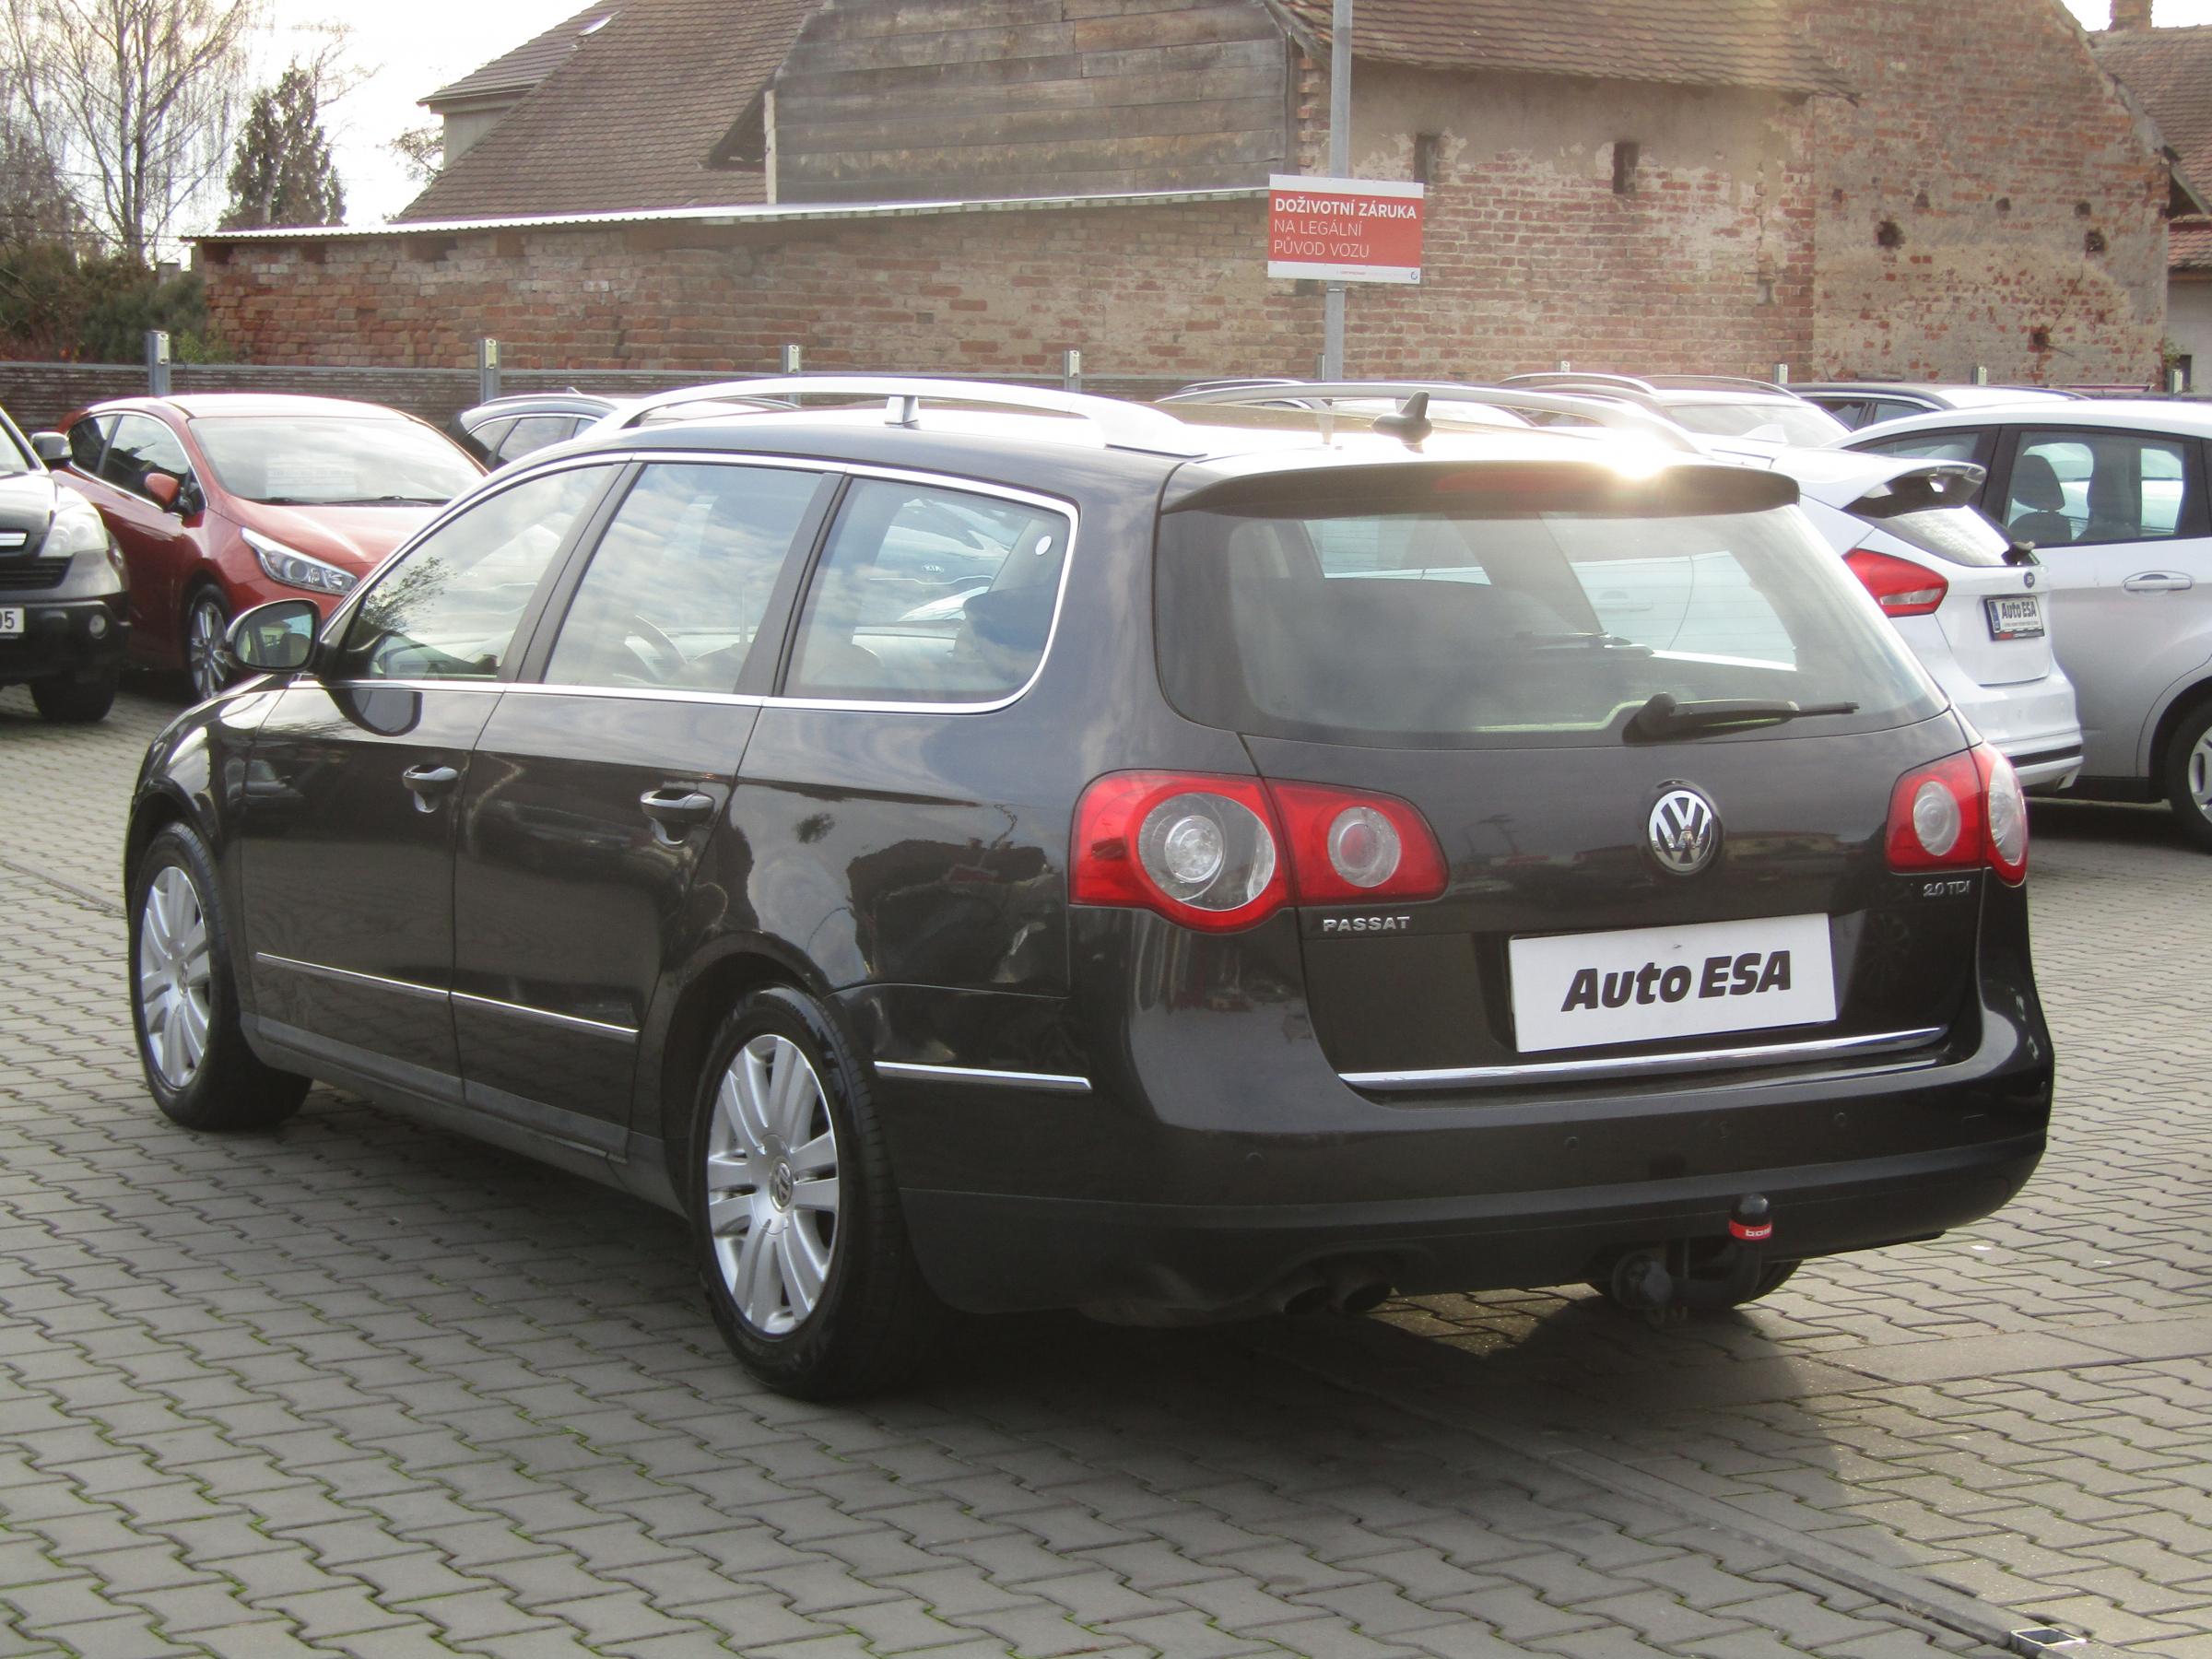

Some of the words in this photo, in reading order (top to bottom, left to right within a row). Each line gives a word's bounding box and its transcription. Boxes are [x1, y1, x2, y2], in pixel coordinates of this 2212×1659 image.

[1275, 195, 1355, 216] DOŽIVOTNÍ
[1358, 200, 1417, 219] ZÁRUKA
[1274, 219, 1296, 234] NA
[1300, 218, 1363, 237] LEGÁLNÍ
[1274, 237, 1325, 256] PŮVOD
[1329, 242, 1370, 258] VOZU
[2002, 602, 2022, 619] Auto
[2021, 600, 2038, 618] ESA
[1947, 879, 1971, 895] TDI
[1323, 915, 1411, 932] PASSAT
[1560, 961, 1692, 1012] Auto
[1698, 950, 1791, 999] ESA
